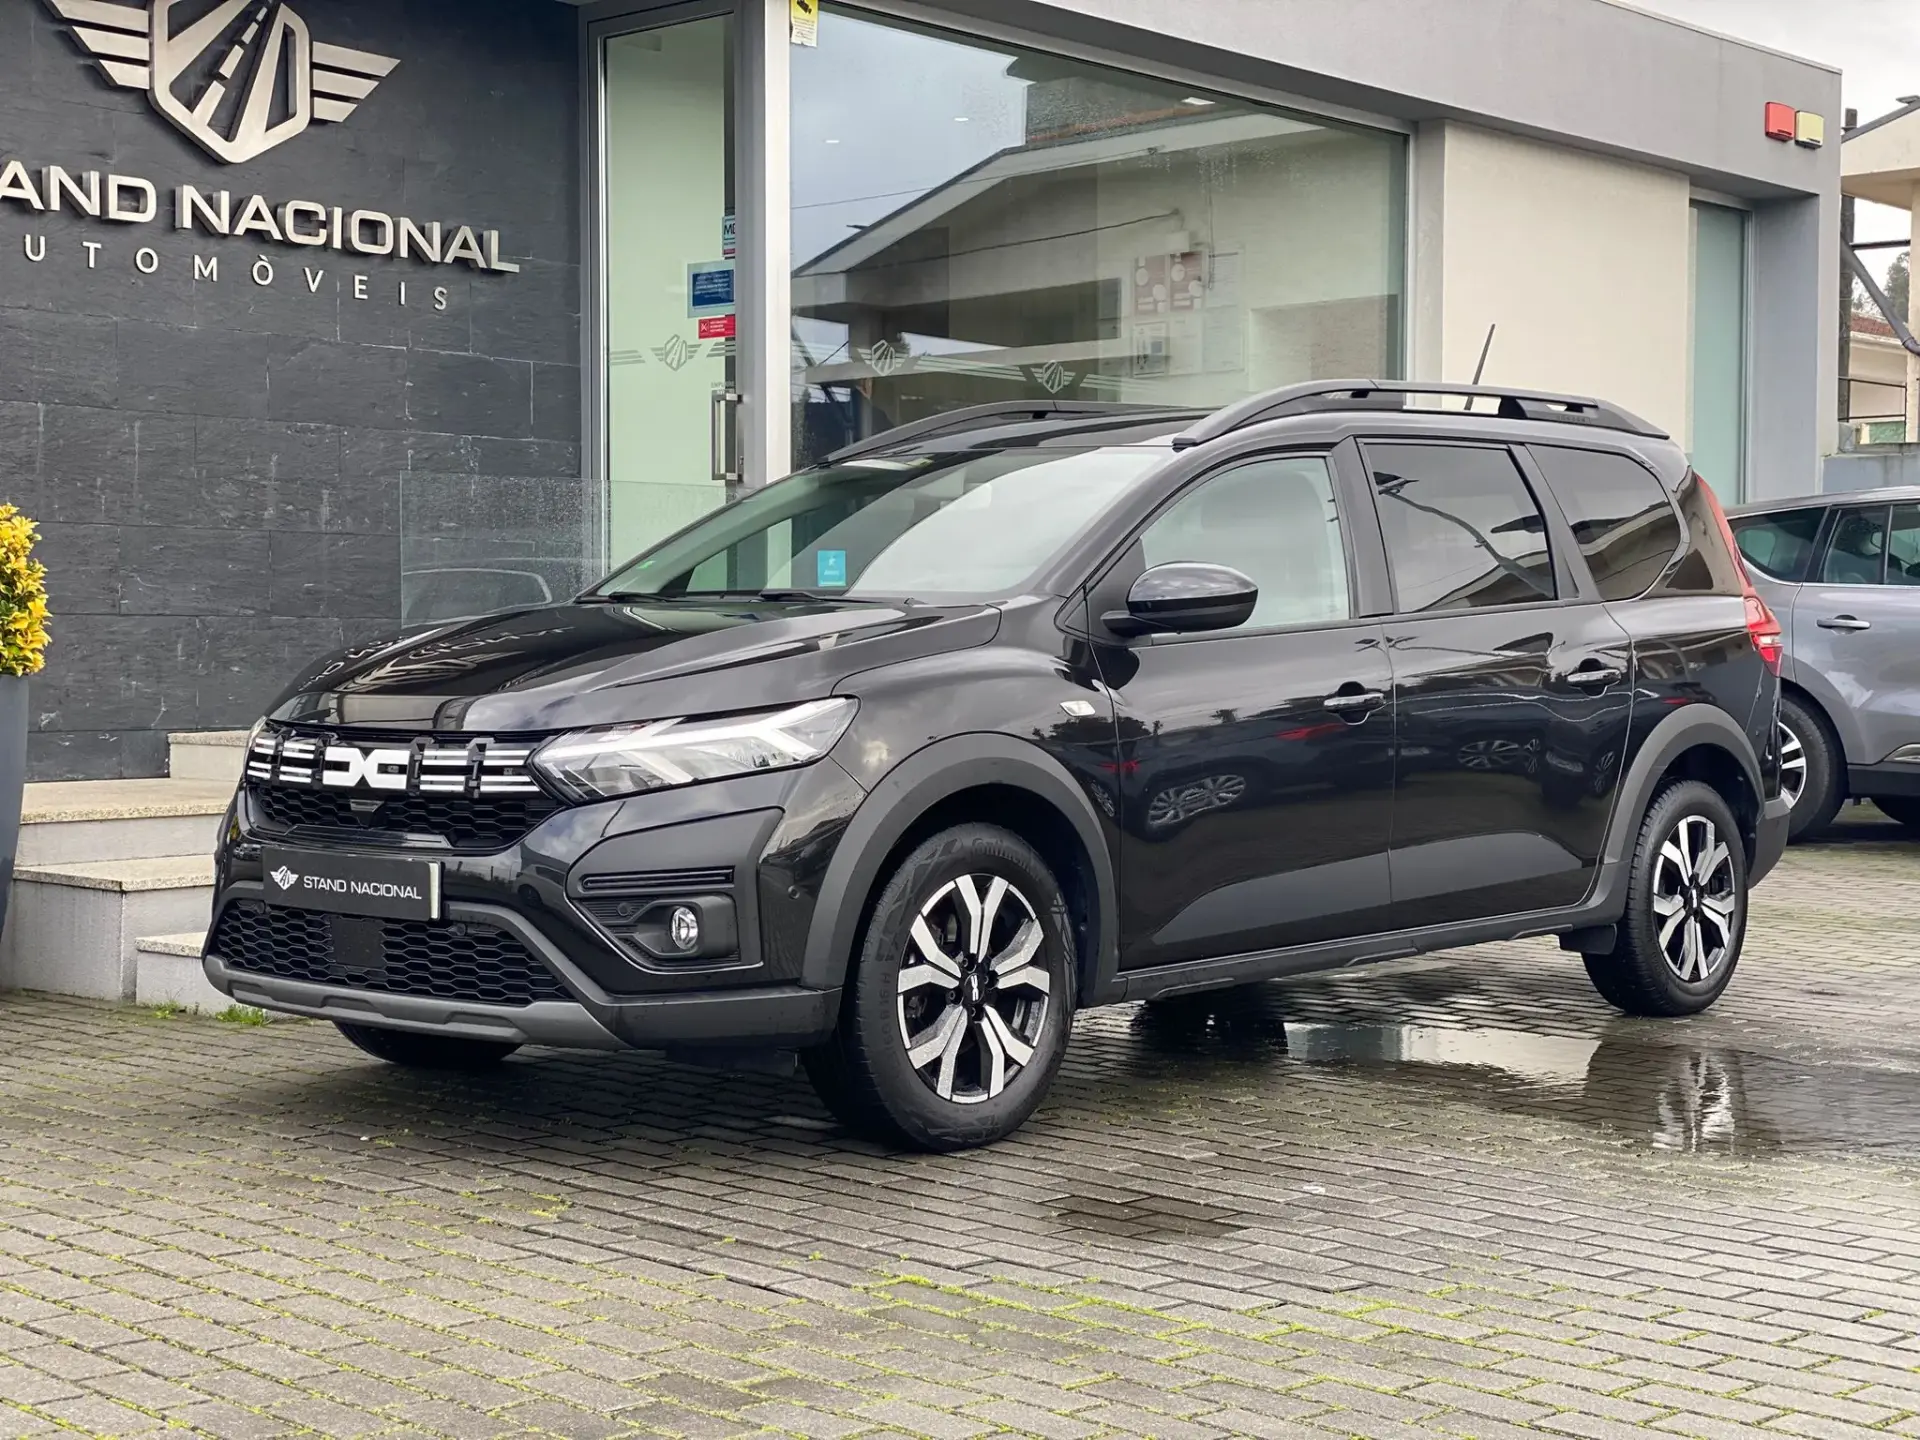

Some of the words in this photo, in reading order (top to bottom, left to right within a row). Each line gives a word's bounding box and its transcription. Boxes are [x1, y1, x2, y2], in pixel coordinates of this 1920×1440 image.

[0, 160, 157, 223] AND
[178, 183, 520, 274] NACIONAL
[303, 875, 347, 893] STAND
[350, 881, 423, 900] NACIONAL
